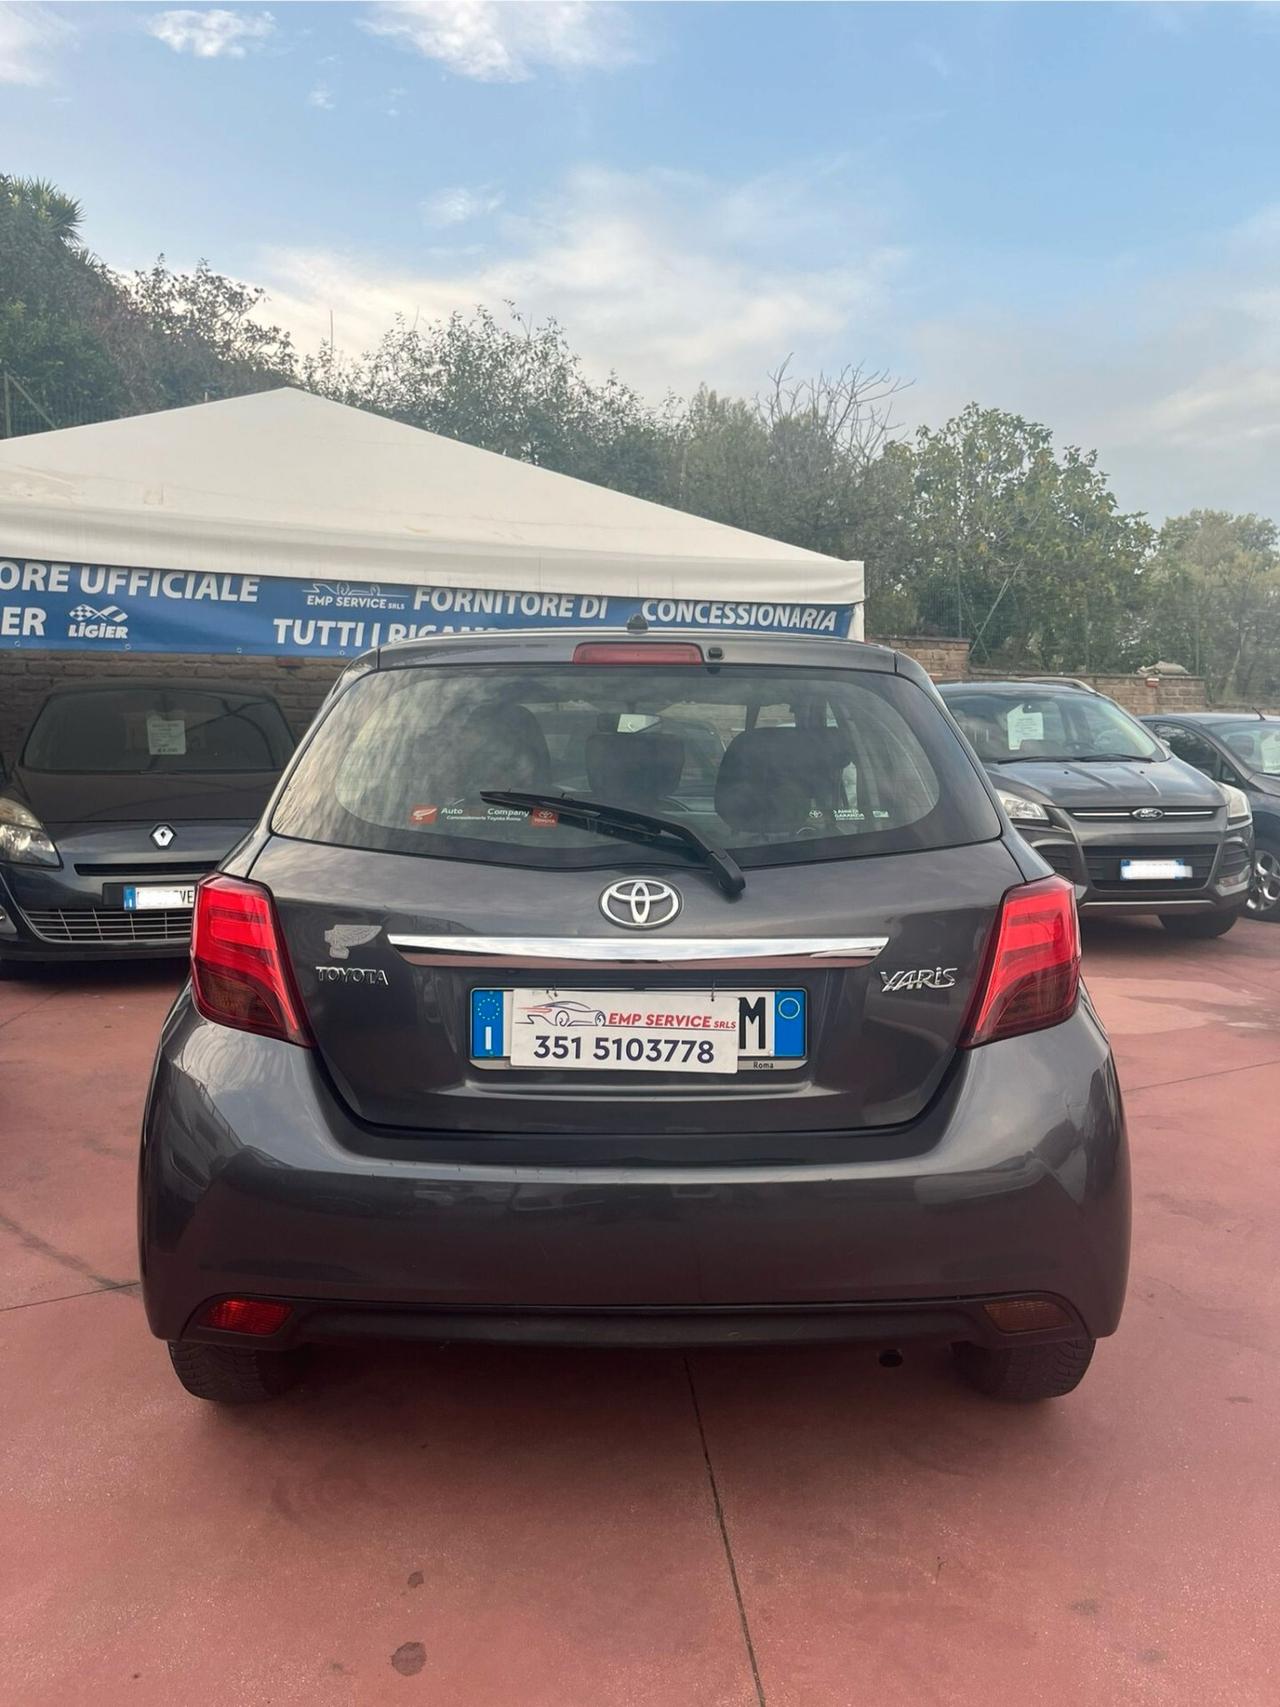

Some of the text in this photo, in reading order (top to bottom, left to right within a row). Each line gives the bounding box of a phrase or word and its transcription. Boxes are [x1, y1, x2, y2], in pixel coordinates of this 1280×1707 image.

[0, 560, 260, 603] ORE UFFICIALE
[307, 595, 333, 606] EMP
[335, 597, 387, 609] SERVICE
[413, 586, 609, 619] FORNITORE DI
[641, 599, 837, 632] CONCESSIONARIA
[1, 606, 47, 637] ER
[273, 618, 365, 647] TUTTI
[371, 622, 381, 648] I
[441, 807, 530, 817] Auto Company
[315, 966, 389, 986] TOYOTA
[608, 1012, 737, 1030] EMP SERVICE SRLS
[738, 996, 766, 1050] M
[533, 1036, 715, 1064] 351 5103778
